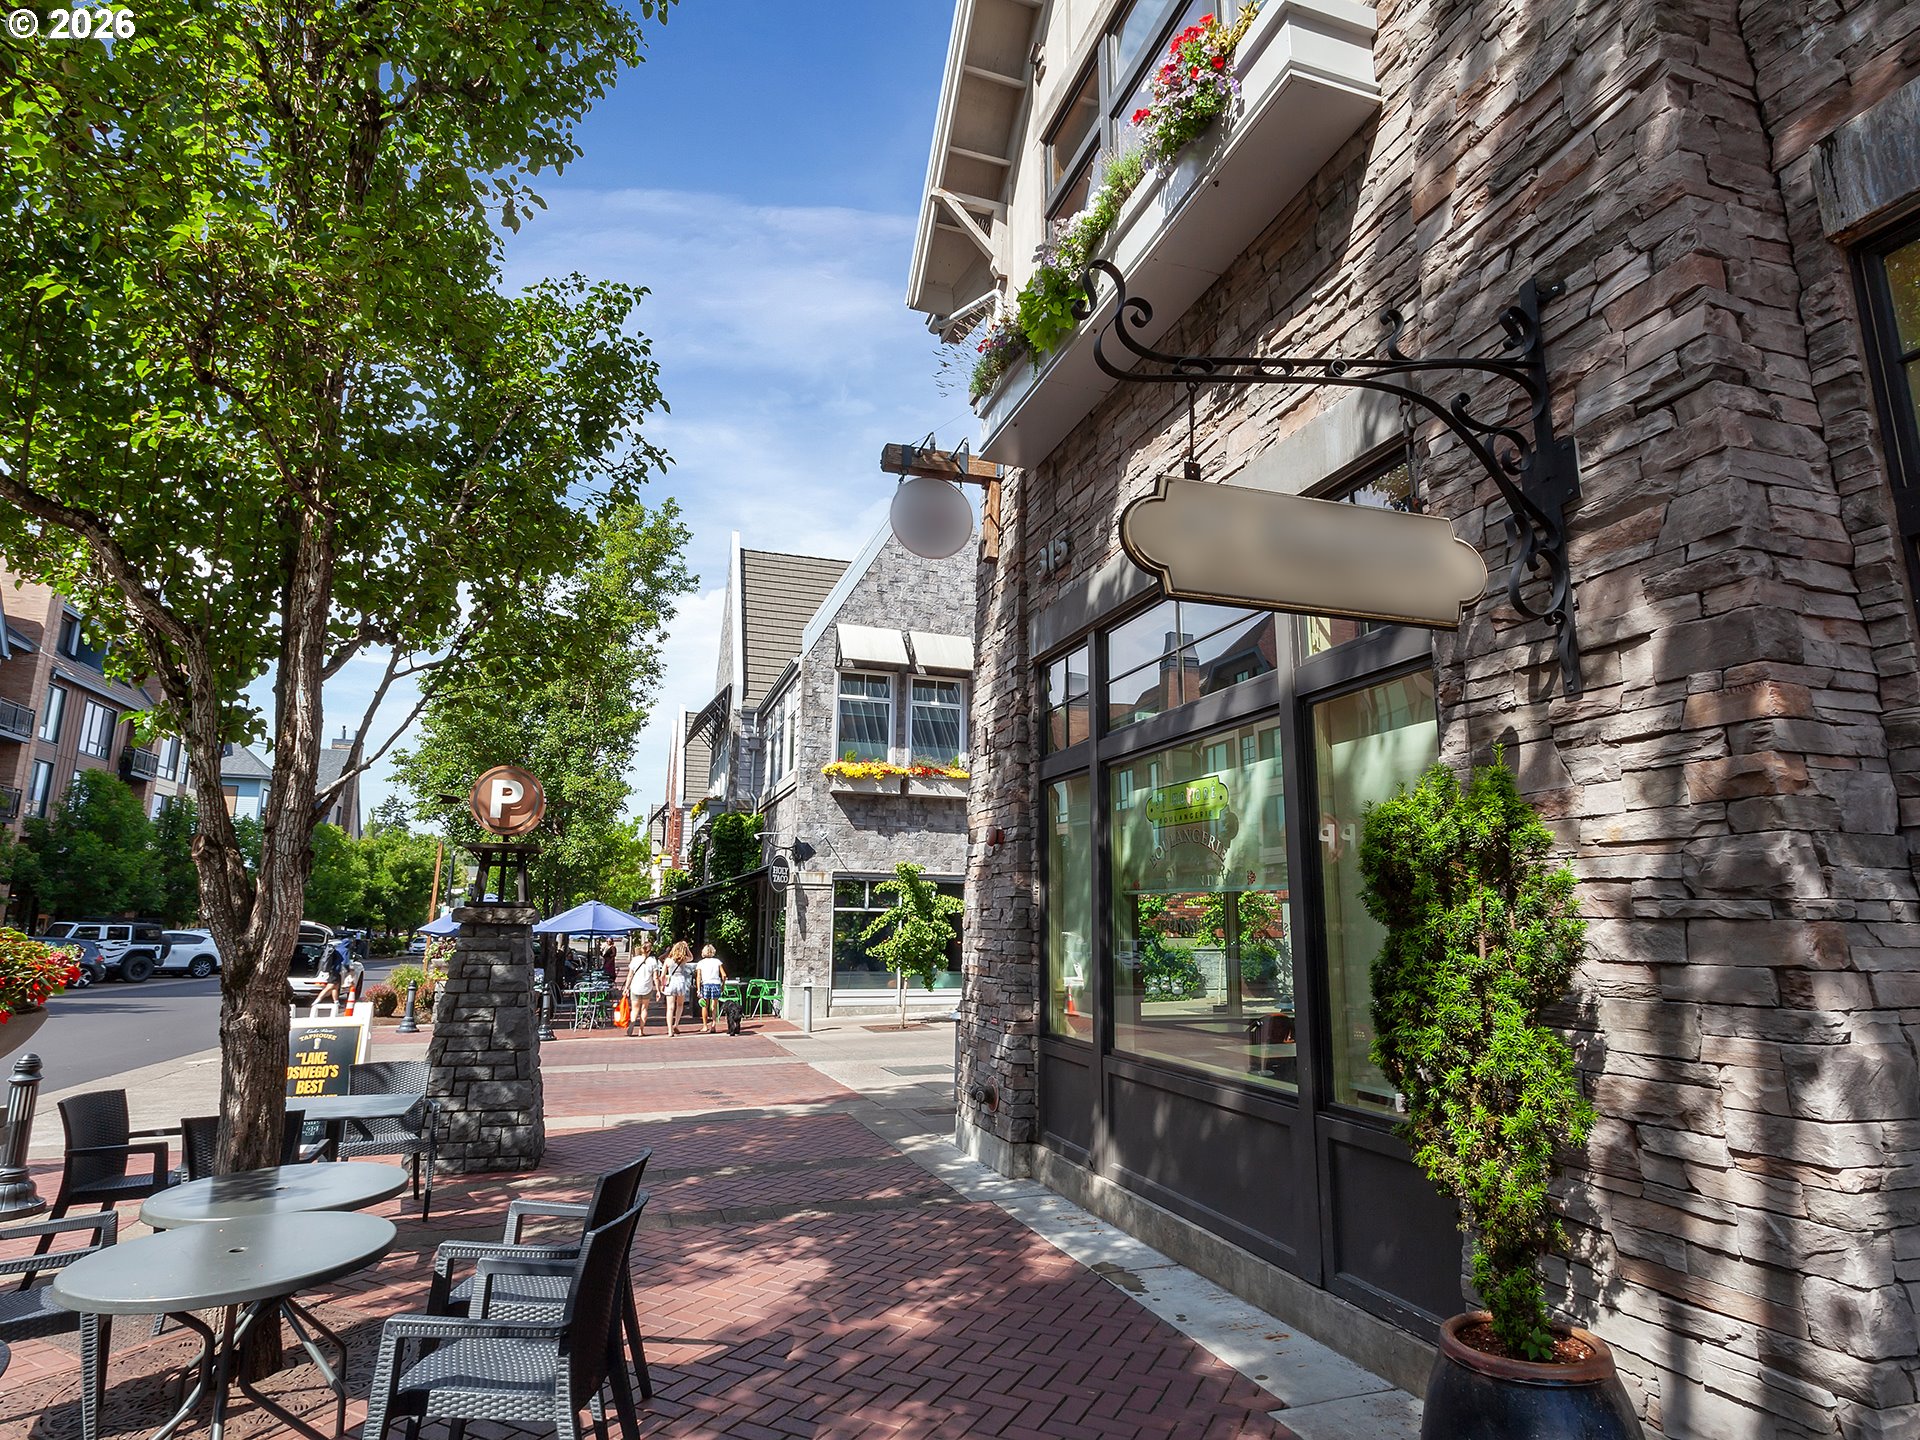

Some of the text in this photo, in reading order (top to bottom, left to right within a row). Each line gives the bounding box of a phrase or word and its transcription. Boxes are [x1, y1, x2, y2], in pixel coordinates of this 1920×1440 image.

[1036, 530, 1069, 577] 315
[490, 779, 525, 819] P
[772, 865, 789, 875] HOLY
[772, 874, 789, 883] TACO
[299, 1033, 338, 1041] TAPHOUSE
[295, 1079, 326, 1095] BEST
